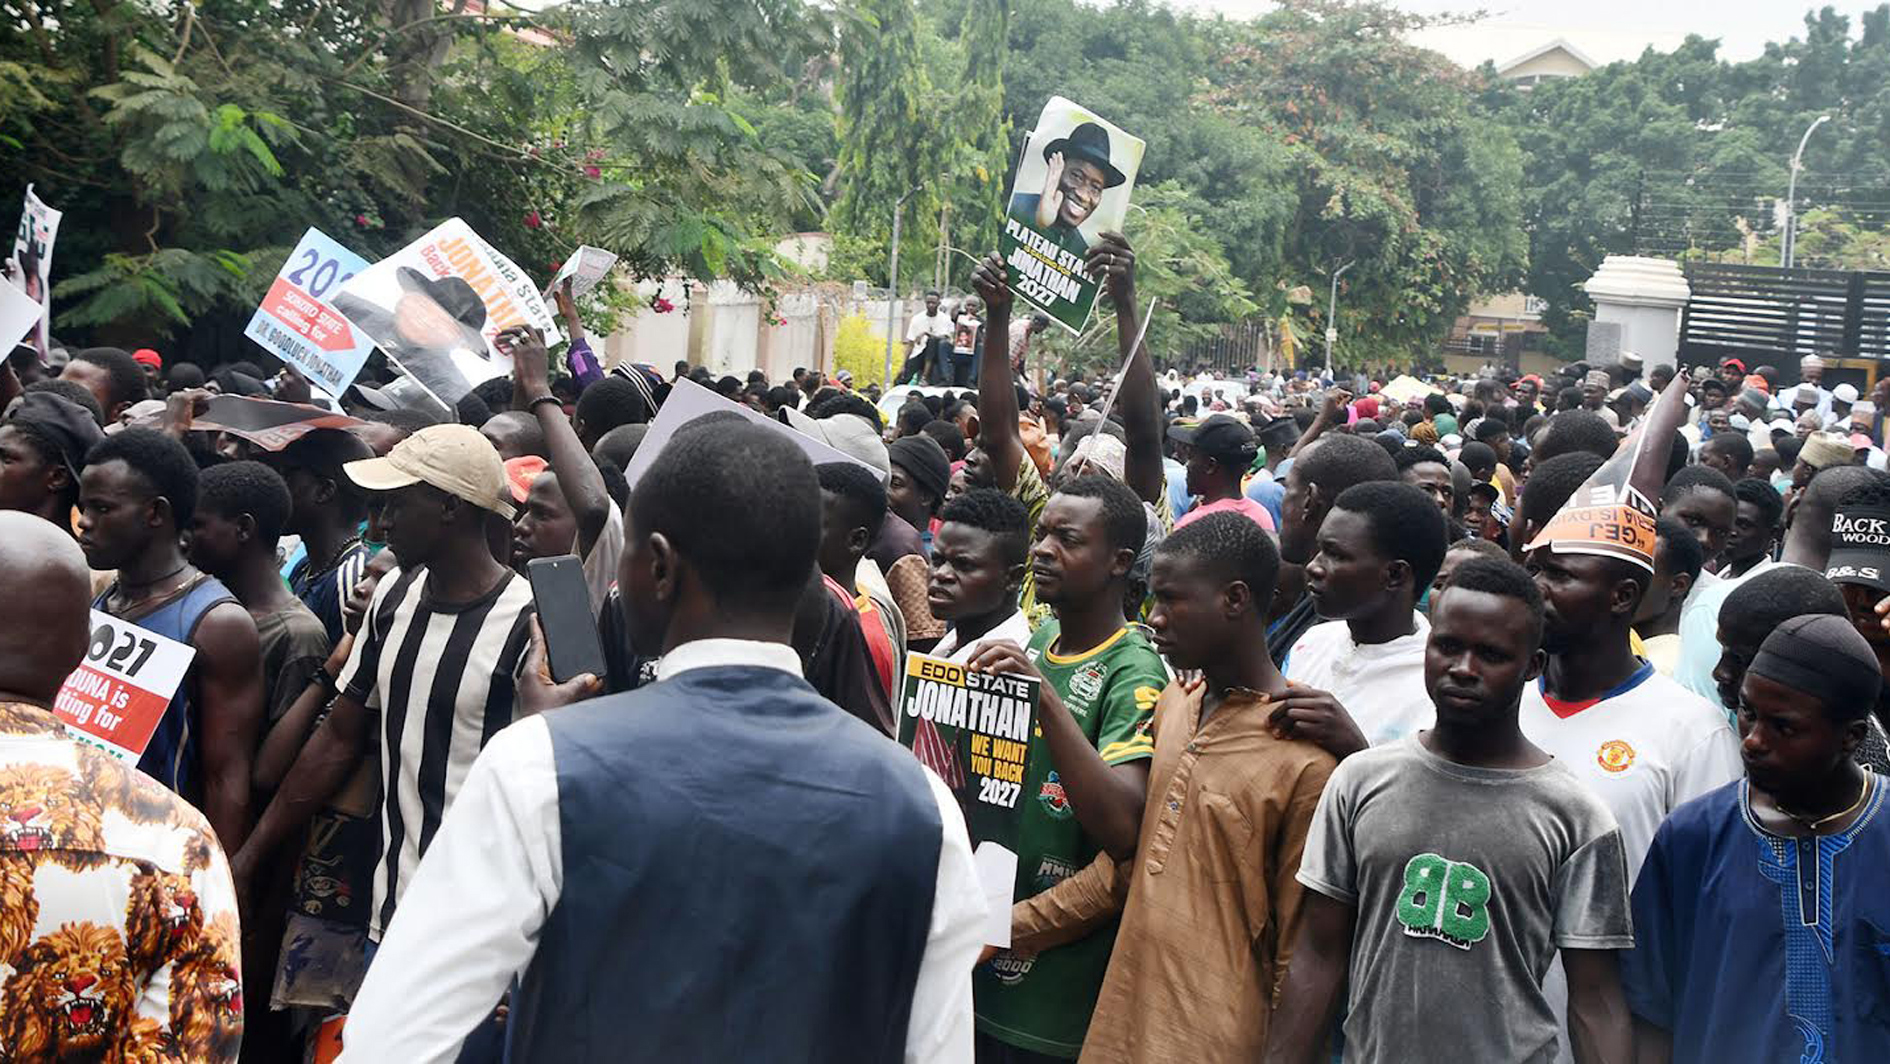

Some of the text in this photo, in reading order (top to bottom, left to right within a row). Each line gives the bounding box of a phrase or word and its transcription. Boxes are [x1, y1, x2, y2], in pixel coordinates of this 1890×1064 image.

[1005, 217, 1060, 261] PLATEAU
[419, 243, 451, 278] Back
[1006, 246, 1082, 304] JONATHAN
[1016, 273, 1058, 307] 2027
[275, 304, 327, 341] calling for
[282, 290, 344, 335] SOKOTO STATE
[267, 327, 309, 364] GOODLUCK
[305, 350, 346, 387] JONATHAN
[1600, 509, 1618, 522] IS
[1831, 512, 1888, 535] BACK
[87, 623, 158, 678] 027
[110, 684, 131, 710] is
[920, 661, 1030, 699] EDO STATE
[93, 704, 124, 732] for
[906, 678, 1032, 743] JONATHAN
[970, 732, 1028, 764] WE WANT
[970, 752, 1025, 784] YOU BACK
[978, 776, 1022, 809] 2027
